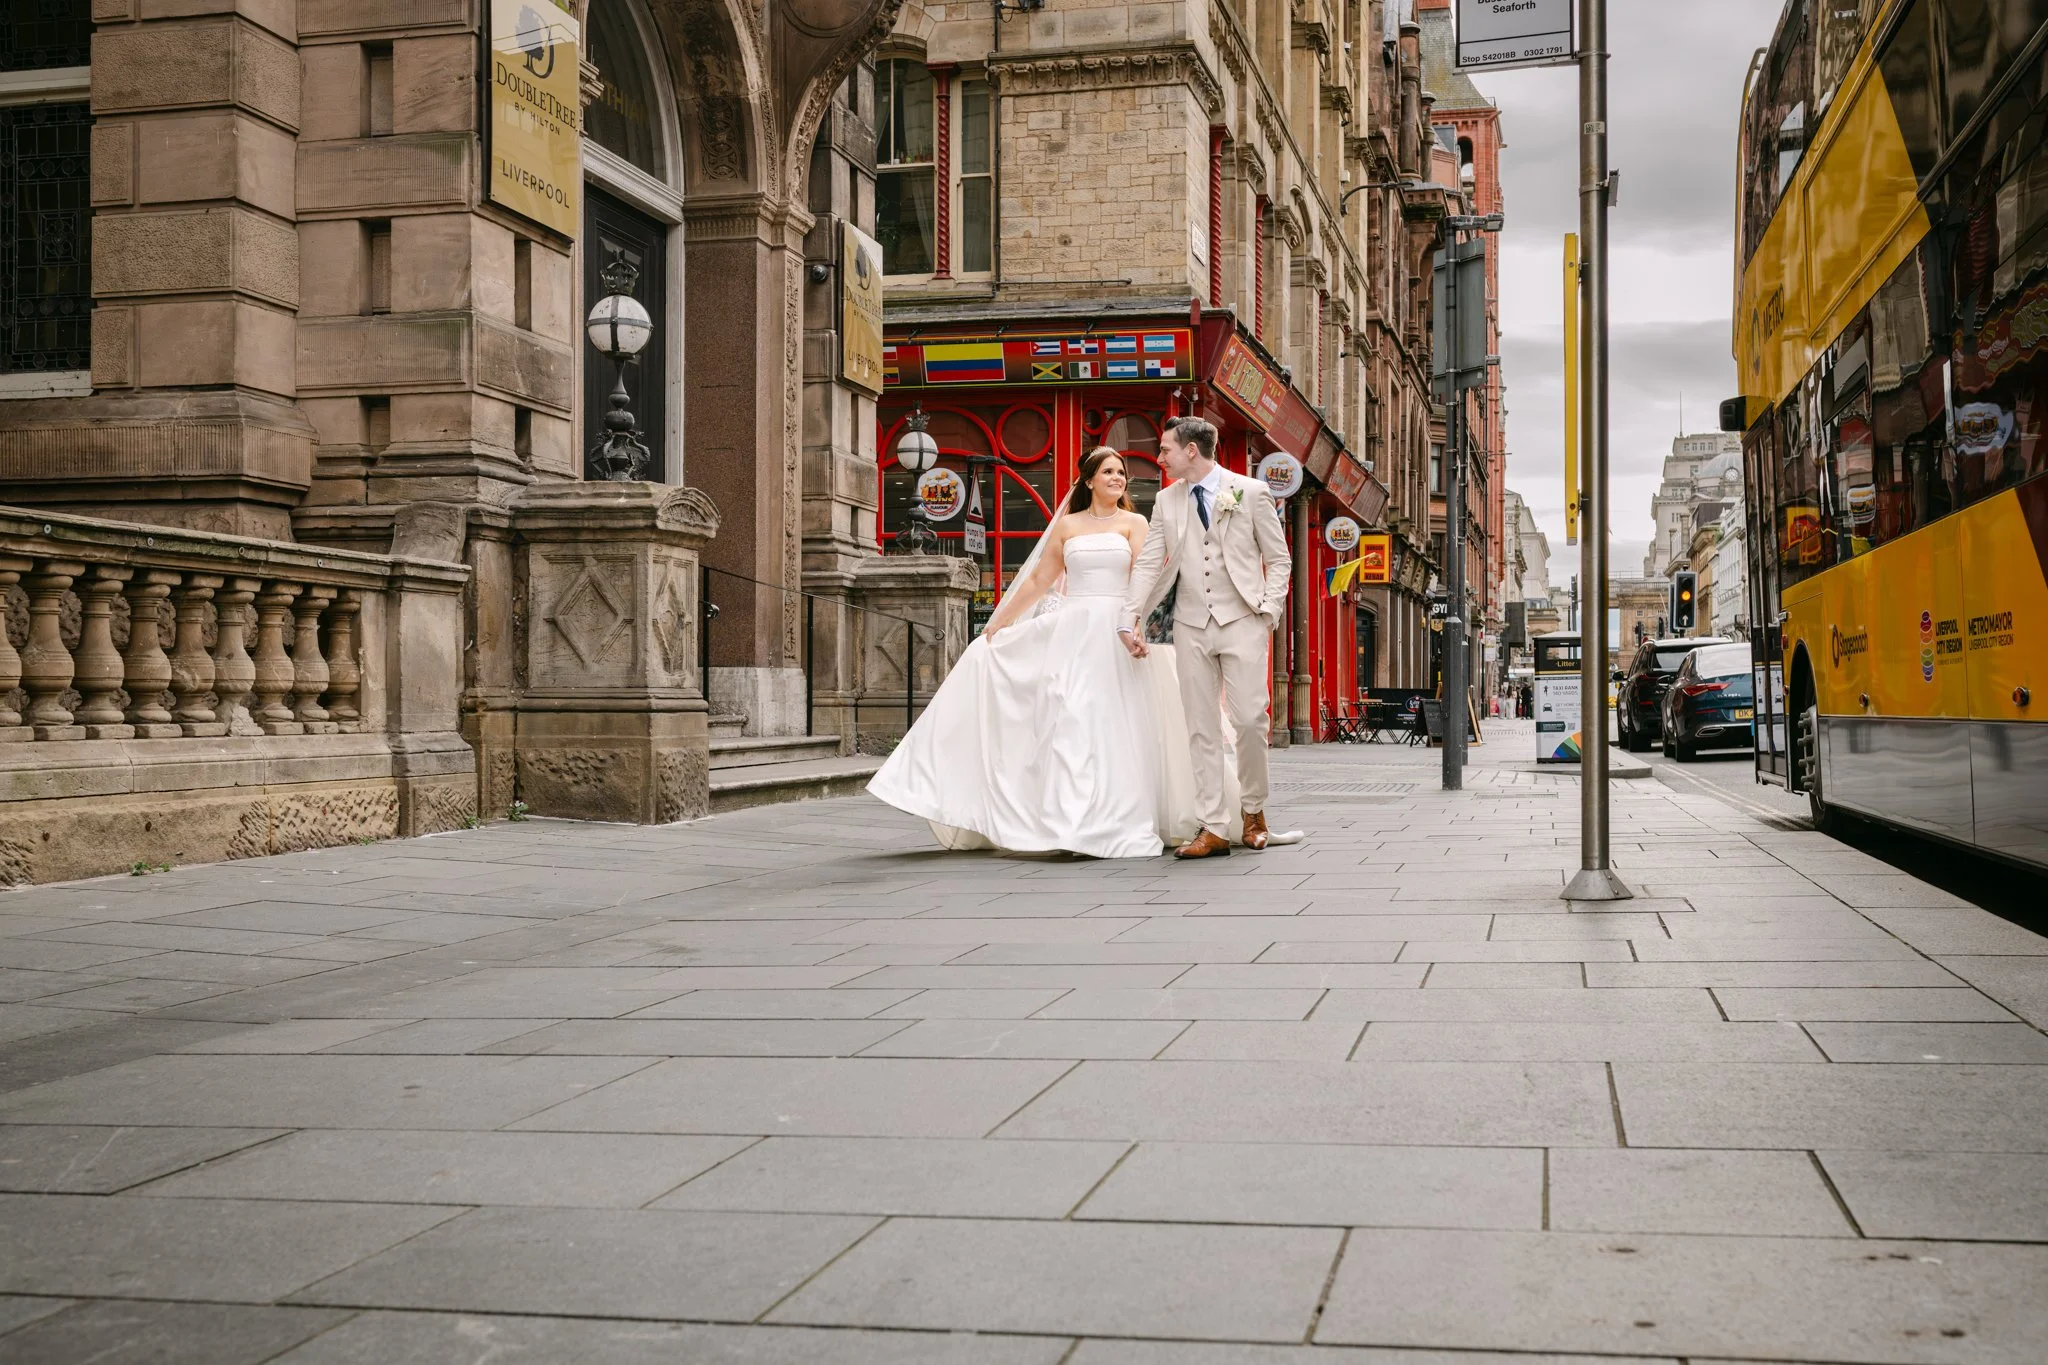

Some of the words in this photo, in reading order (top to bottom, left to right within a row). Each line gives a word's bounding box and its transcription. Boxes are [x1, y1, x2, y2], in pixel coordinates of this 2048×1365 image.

[1492, 1, 1536, 13] Seaforth
[1462, 55, 1480, 63] Stop
[1482, 52, 1516, 61] S42018B
[1524, 49, 1544, 57] 0302
[1546, 46, 1563, 54] 1791
[514, 102, 526, 114] BY
[530, 112, 561, 136] HILTON
[502, 159, 570, 209] LIVERPOOL
[1763, 283, 1785, 344] METRO
[1935, 619, 1958, 636] LIVERPOOL
[1839, 625, 1868, 662] Stagecoach
[1936, 639, 1945, 655] CITY
